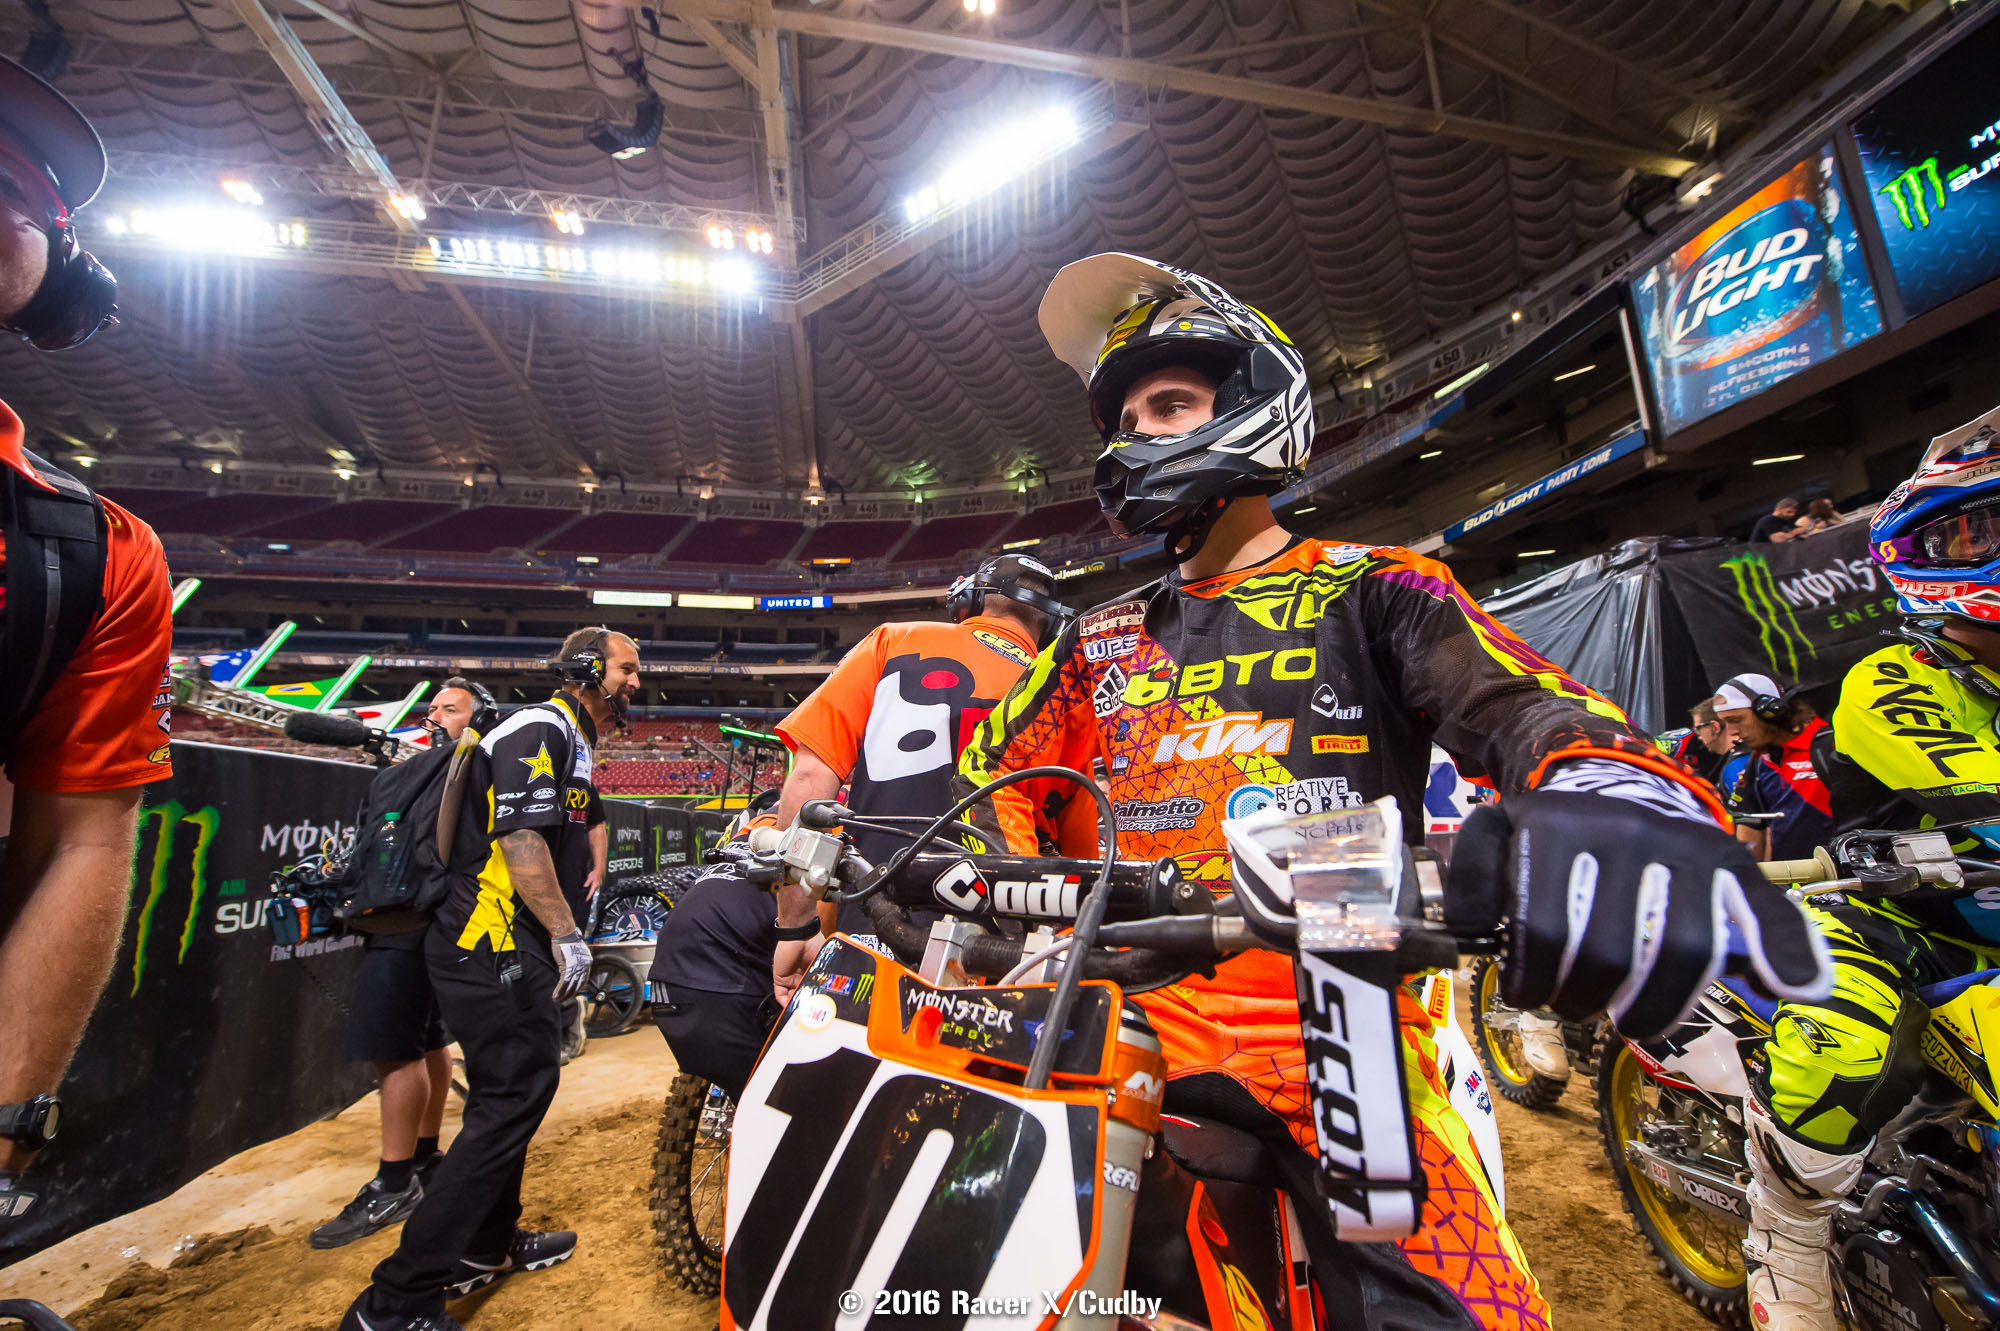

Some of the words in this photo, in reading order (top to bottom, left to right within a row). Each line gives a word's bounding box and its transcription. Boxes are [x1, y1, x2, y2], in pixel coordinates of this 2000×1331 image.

[1687, 227, 1808, 304] BUD
[1672, 254, 1824, 343] LIGHT
[1432, 348, 1461, 370] 450
[1708, 355, 1811, 394] REFRESHING
[1728, 346, 1797, 375] SMOOTH
[751, 501, 772, 512] 444
[1068, 483, 1088, 494] 447
[1463, 508, 1494, 532] BUD
[1500, 483, 1544, 514] LIGHT
[1545, 464, 1580, 492] PARTY
[1580, 448, 1613, 474] ZONE
[767, 598, 811, 609] UNITED
[1152, 713, 1292, 764] KTM
[1113, 798, 1205, 819] Palmetto
[906, 987, 1014, 1034] MONSTER
[1428, 977, 1447, 1020] PIRELLI
[1627, 1040, 1660, 1072] SUZUKI
[1920, 1028, 1975, 1096] SUZUKI
[1464, 1069, 1483, 1098] AMA
[724, 1047, 1047, 1331] 10
[1678, 1173, 1745, 1219] VORTEX
